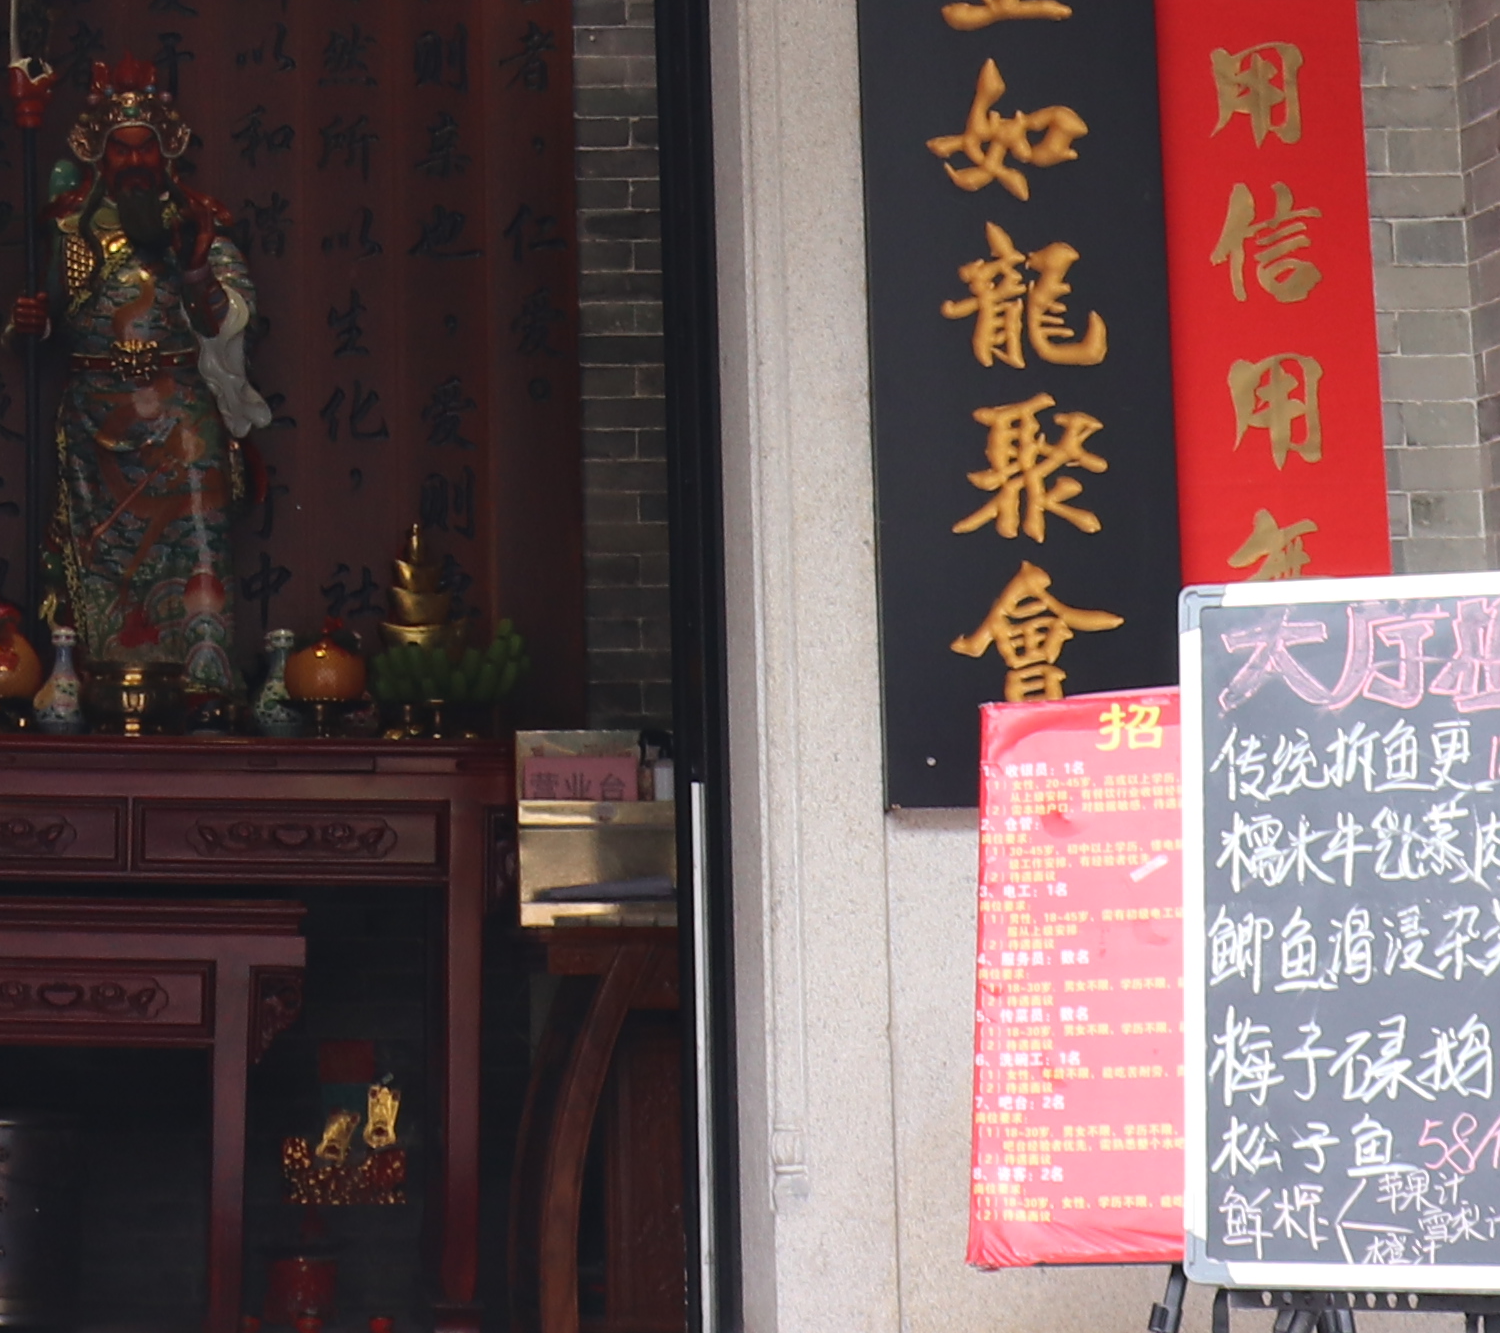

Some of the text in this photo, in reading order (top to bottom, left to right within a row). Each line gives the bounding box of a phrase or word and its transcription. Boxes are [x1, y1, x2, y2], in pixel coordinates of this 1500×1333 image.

[1095, 703, 1164, 751] 招
[1210, 1112, 1419, 1178] 松子鱼
